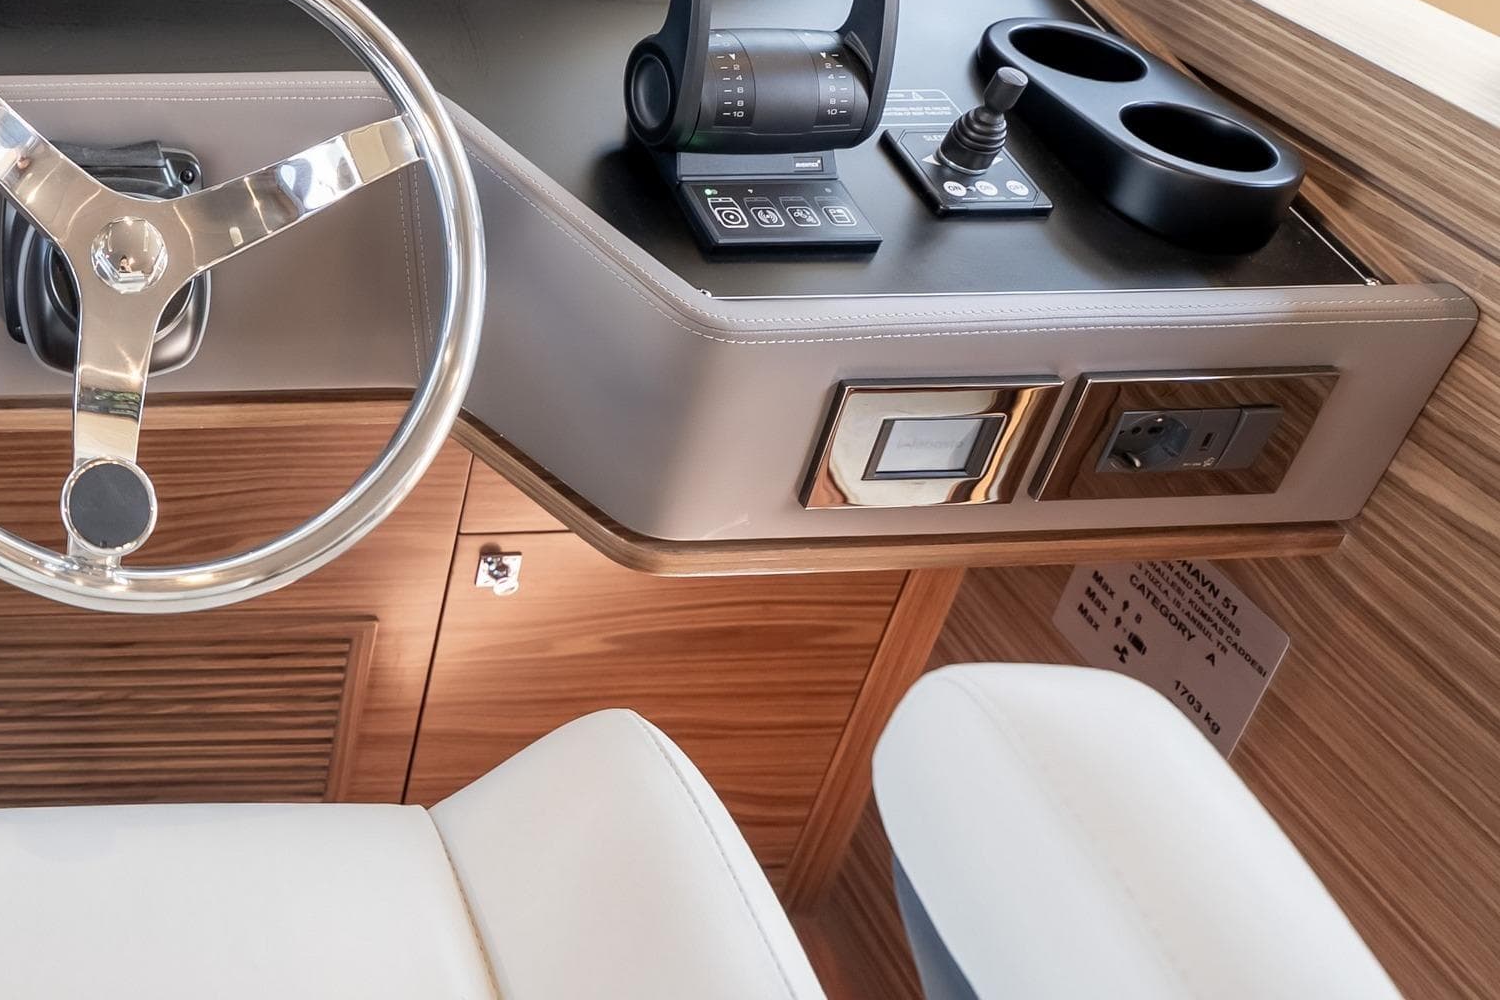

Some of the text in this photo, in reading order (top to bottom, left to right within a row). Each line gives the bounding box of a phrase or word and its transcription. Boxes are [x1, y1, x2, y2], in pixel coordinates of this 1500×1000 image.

[1084, 586, 1109, 616] Max
[1092, 570, 1117, 600] Max
[1176, 559, 1238, 617] HAVN 51
[1129, 574, 1217, 667] CATEGORY A
[1077, 602, 1222, 735] Max 1703 kg
